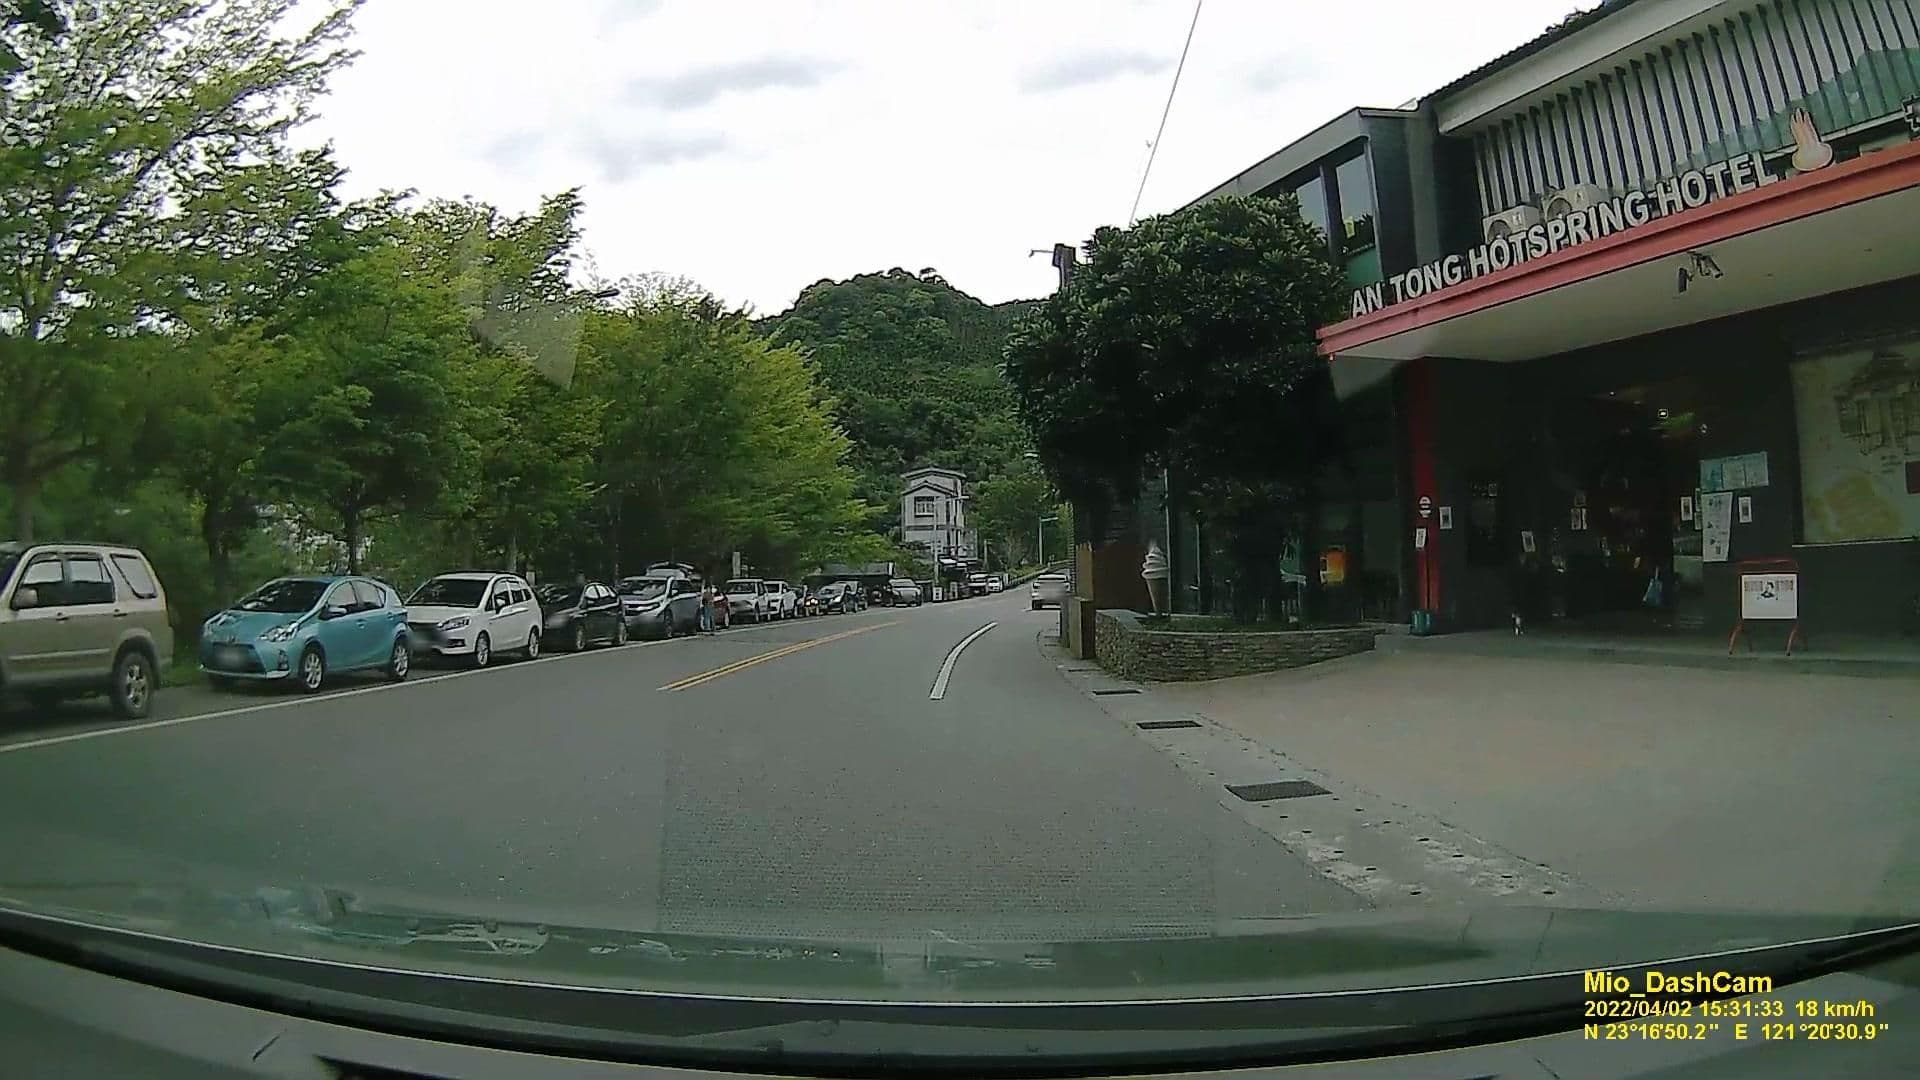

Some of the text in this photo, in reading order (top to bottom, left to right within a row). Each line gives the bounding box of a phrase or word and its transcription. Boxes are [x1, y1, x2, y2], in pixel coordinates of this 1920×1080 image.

[1351, 150, 1779, 319] AN TONG HOTSPRING HOTEL
